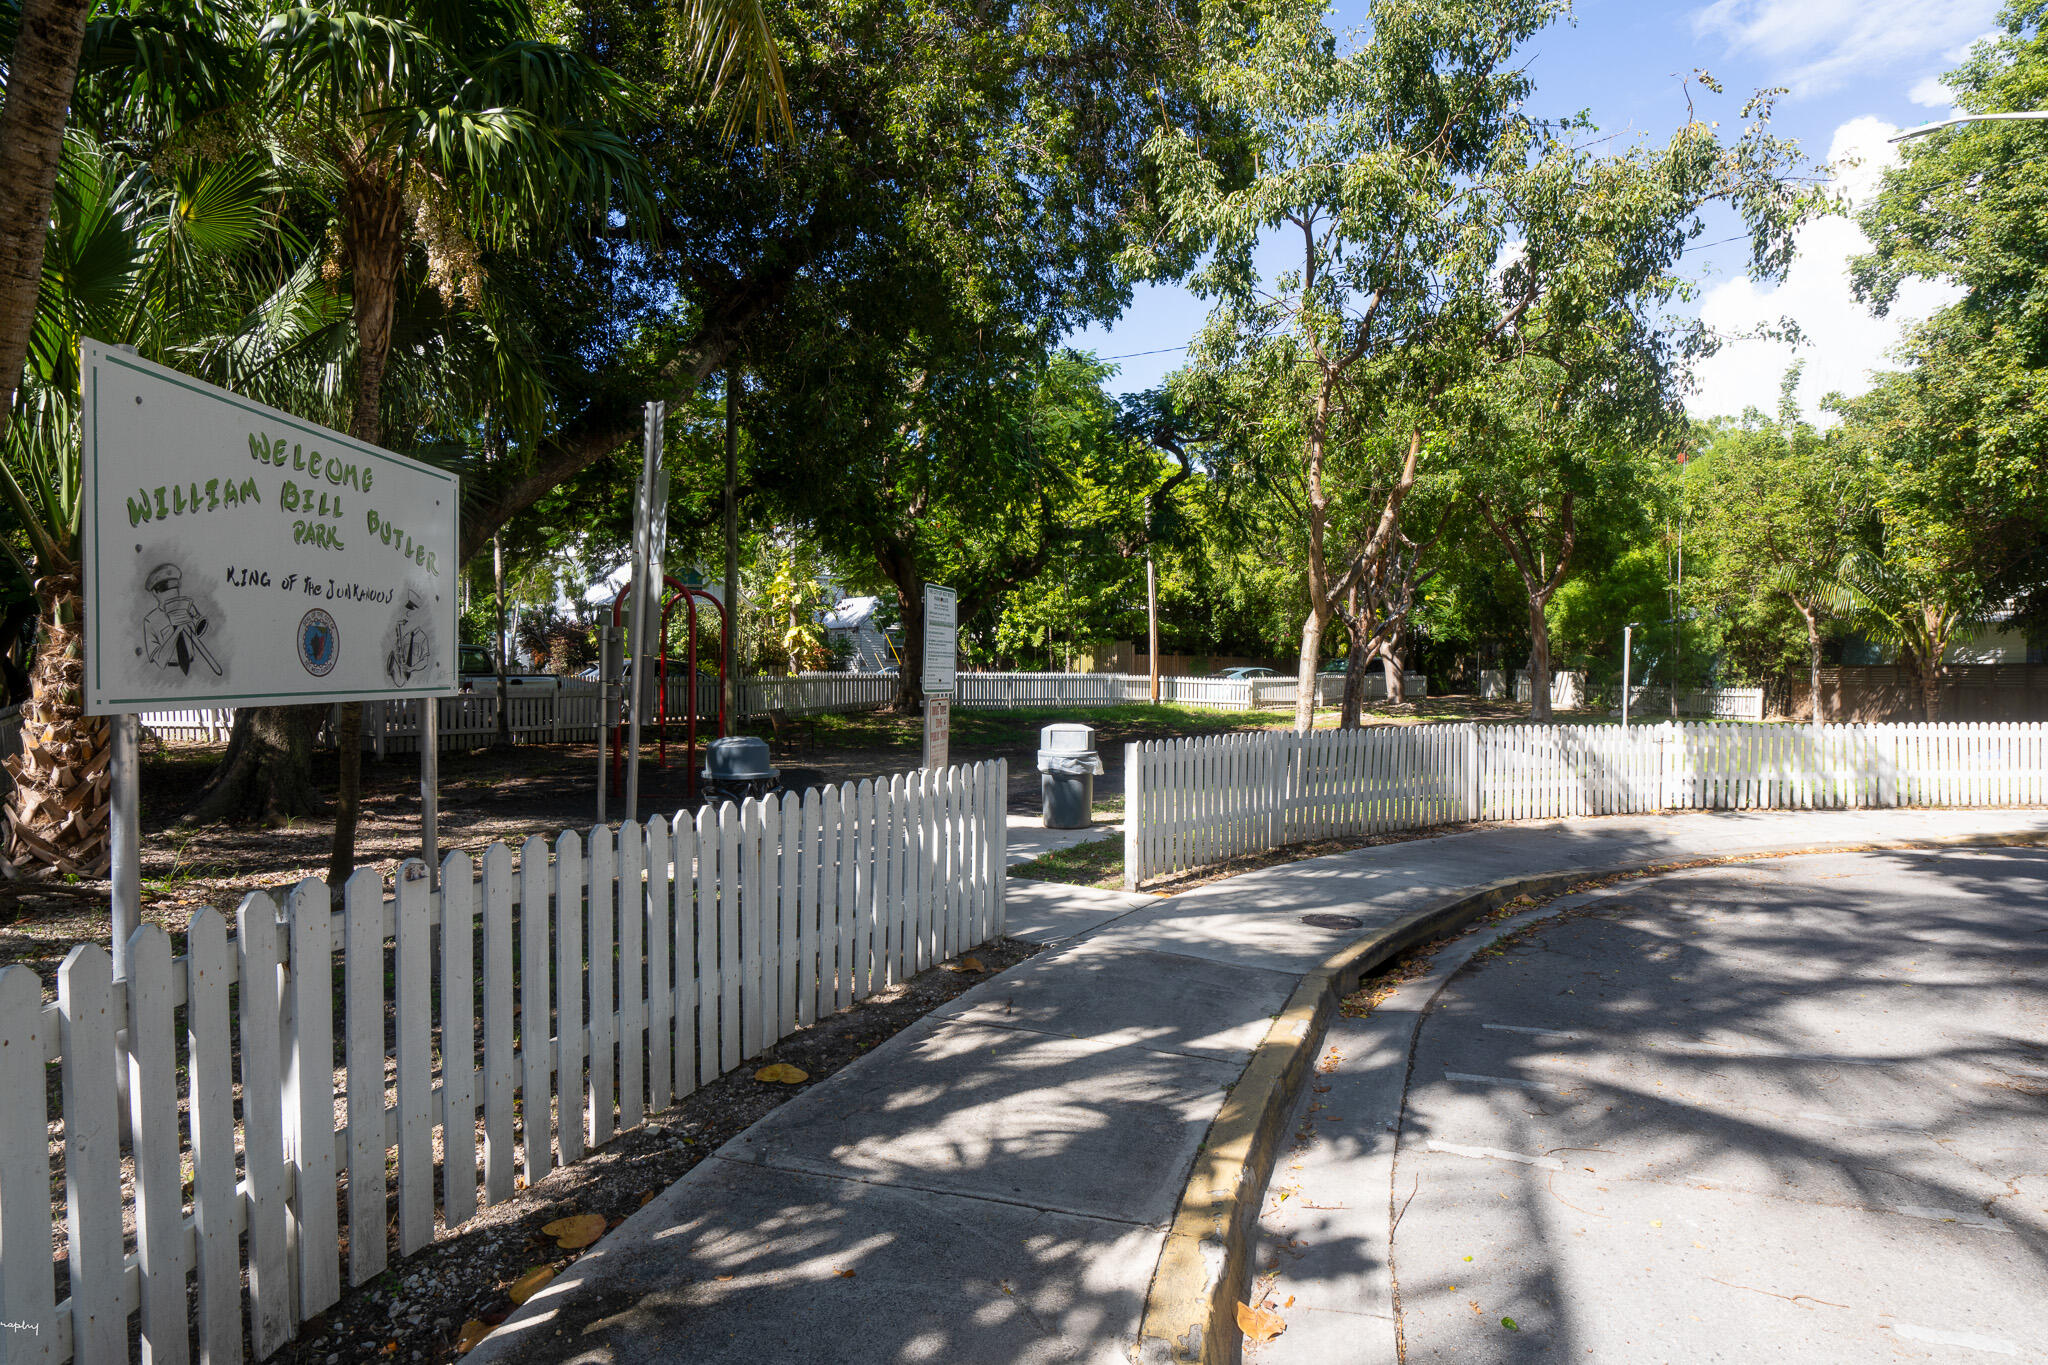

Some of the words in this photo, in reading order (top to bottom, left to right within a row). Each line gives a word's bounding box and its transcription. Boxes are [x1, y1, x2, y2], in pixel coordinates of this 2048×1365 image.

[248, 431, 374, 493] WELCOME
[127, 476, 262, 529] WILLIAM
[280, 480, 344, 519] BILL
[366, 509, 440, 577] BUTLER
[292, 519, 345, 551] PARK
[226, 565, 271, 587] KING
[281, 573, 298, 591] OF
[326, 578, 394, 605] JUNKANOOS
